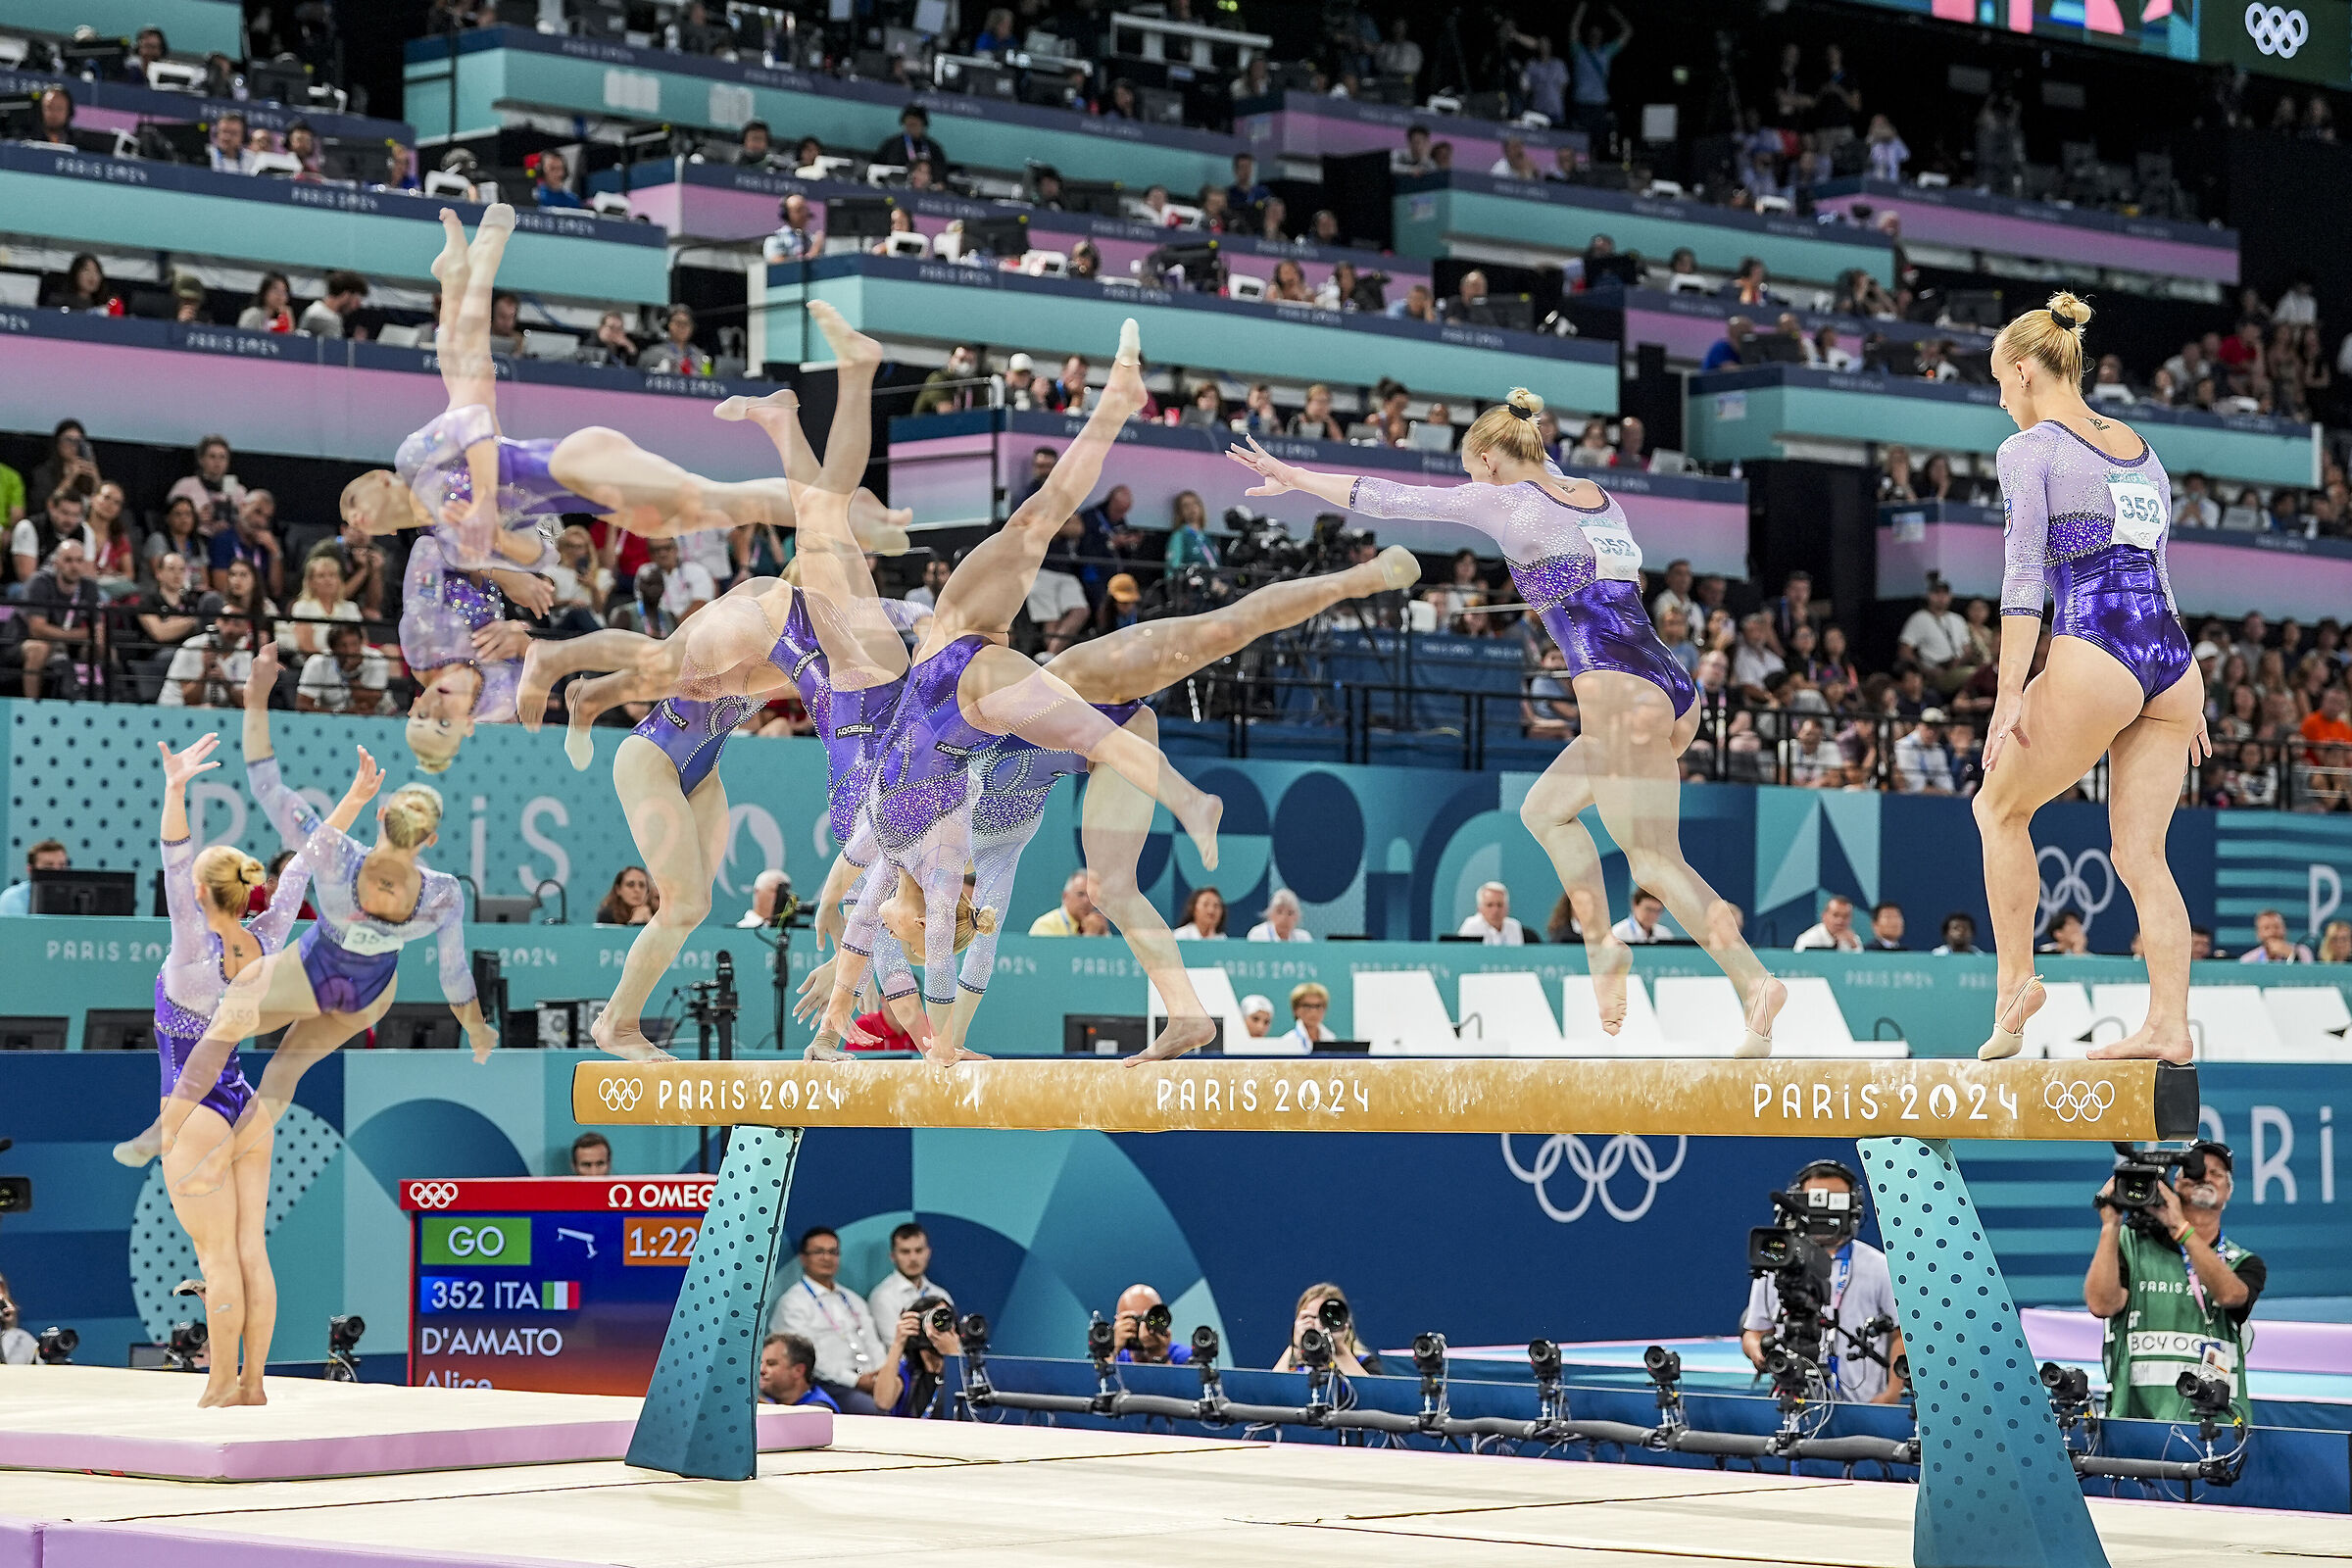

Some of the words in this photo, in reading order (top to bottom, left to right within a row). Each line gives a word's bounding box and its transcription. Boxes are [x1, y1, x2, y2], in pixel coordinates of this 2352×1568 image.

[2120, 495, 2161, 524] 352
[1593, 536, 1636, 557] 352
[836, 724, 873, 738] FREDDY
[129, 942, 164, 961] 20
[759, 1080, 840, 1109] 2024
[1274, 1079, 1368, 1111] 2024
[1899, 1083, 2018, 1120] 2024
[638, 1184, 714, 1207] OMEG
[448, 1226, 505, 1256] GO
[629, 1226, 698, 1257] 1:22
[431, 1281, 485, 1309] 352
[494, 1281, 539, 1309] ITA
[421, 1327, 564, 1357] D'AMATO
